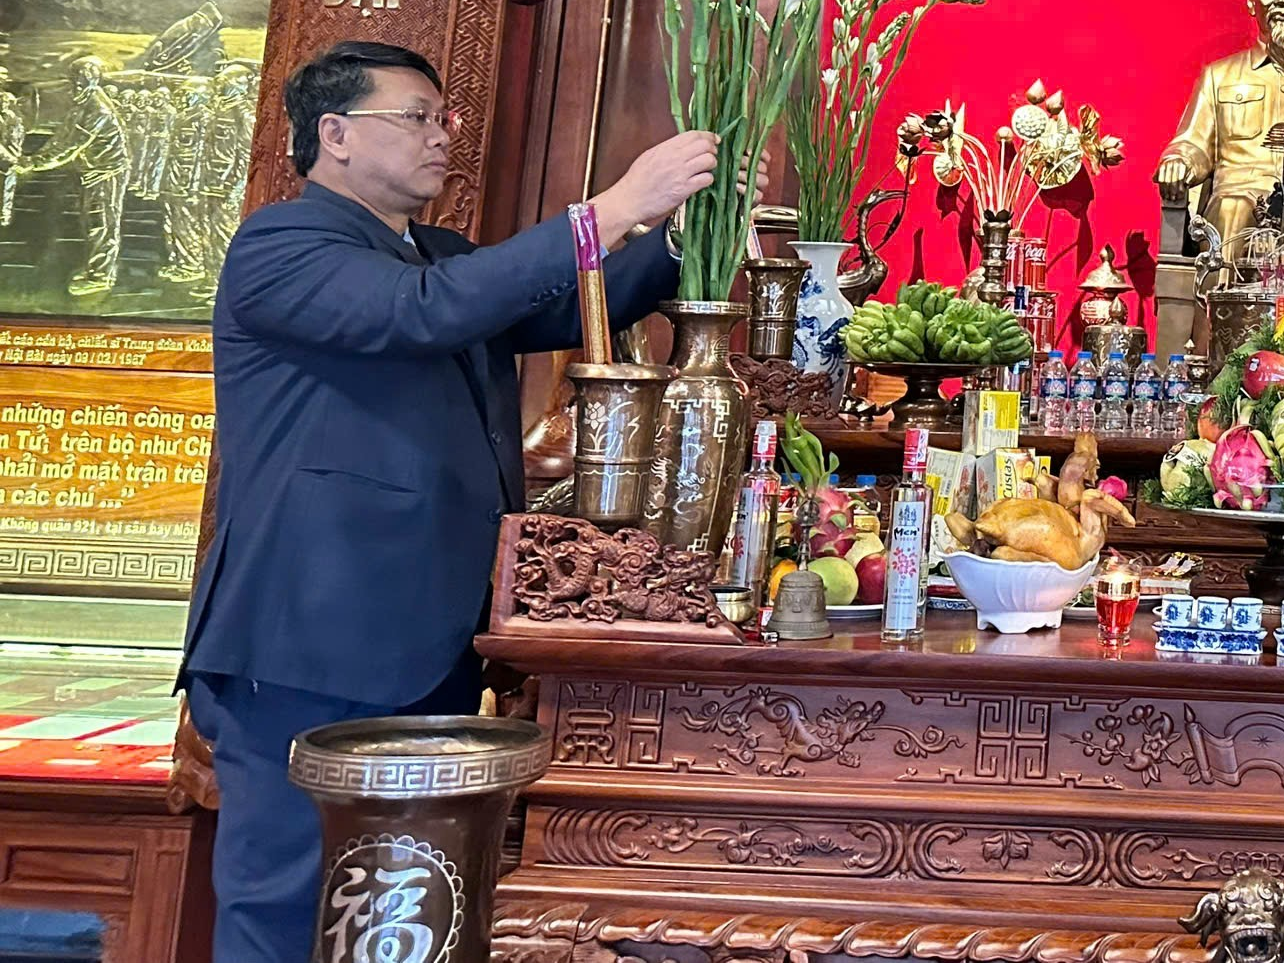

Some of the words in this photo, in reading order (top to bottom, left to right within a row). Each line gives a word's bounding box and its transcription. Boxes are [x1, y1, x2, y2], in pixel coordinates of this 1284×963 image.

[2, 402, 65, 430] những
[71, 404, 128, 427] chiến
[134, 406, 184, 433] công
[61, 430, 102, 454] trên
[109, 433, 134, 460] bộ
[140, 435, 181, 456] như
[41, 454, 76, 479] mở
[79, 460, 120, 486] mặt
[126, 459, 167, 488] trận
[11, 483, 49, 506] các
[56, 485, 95, 507] chú
